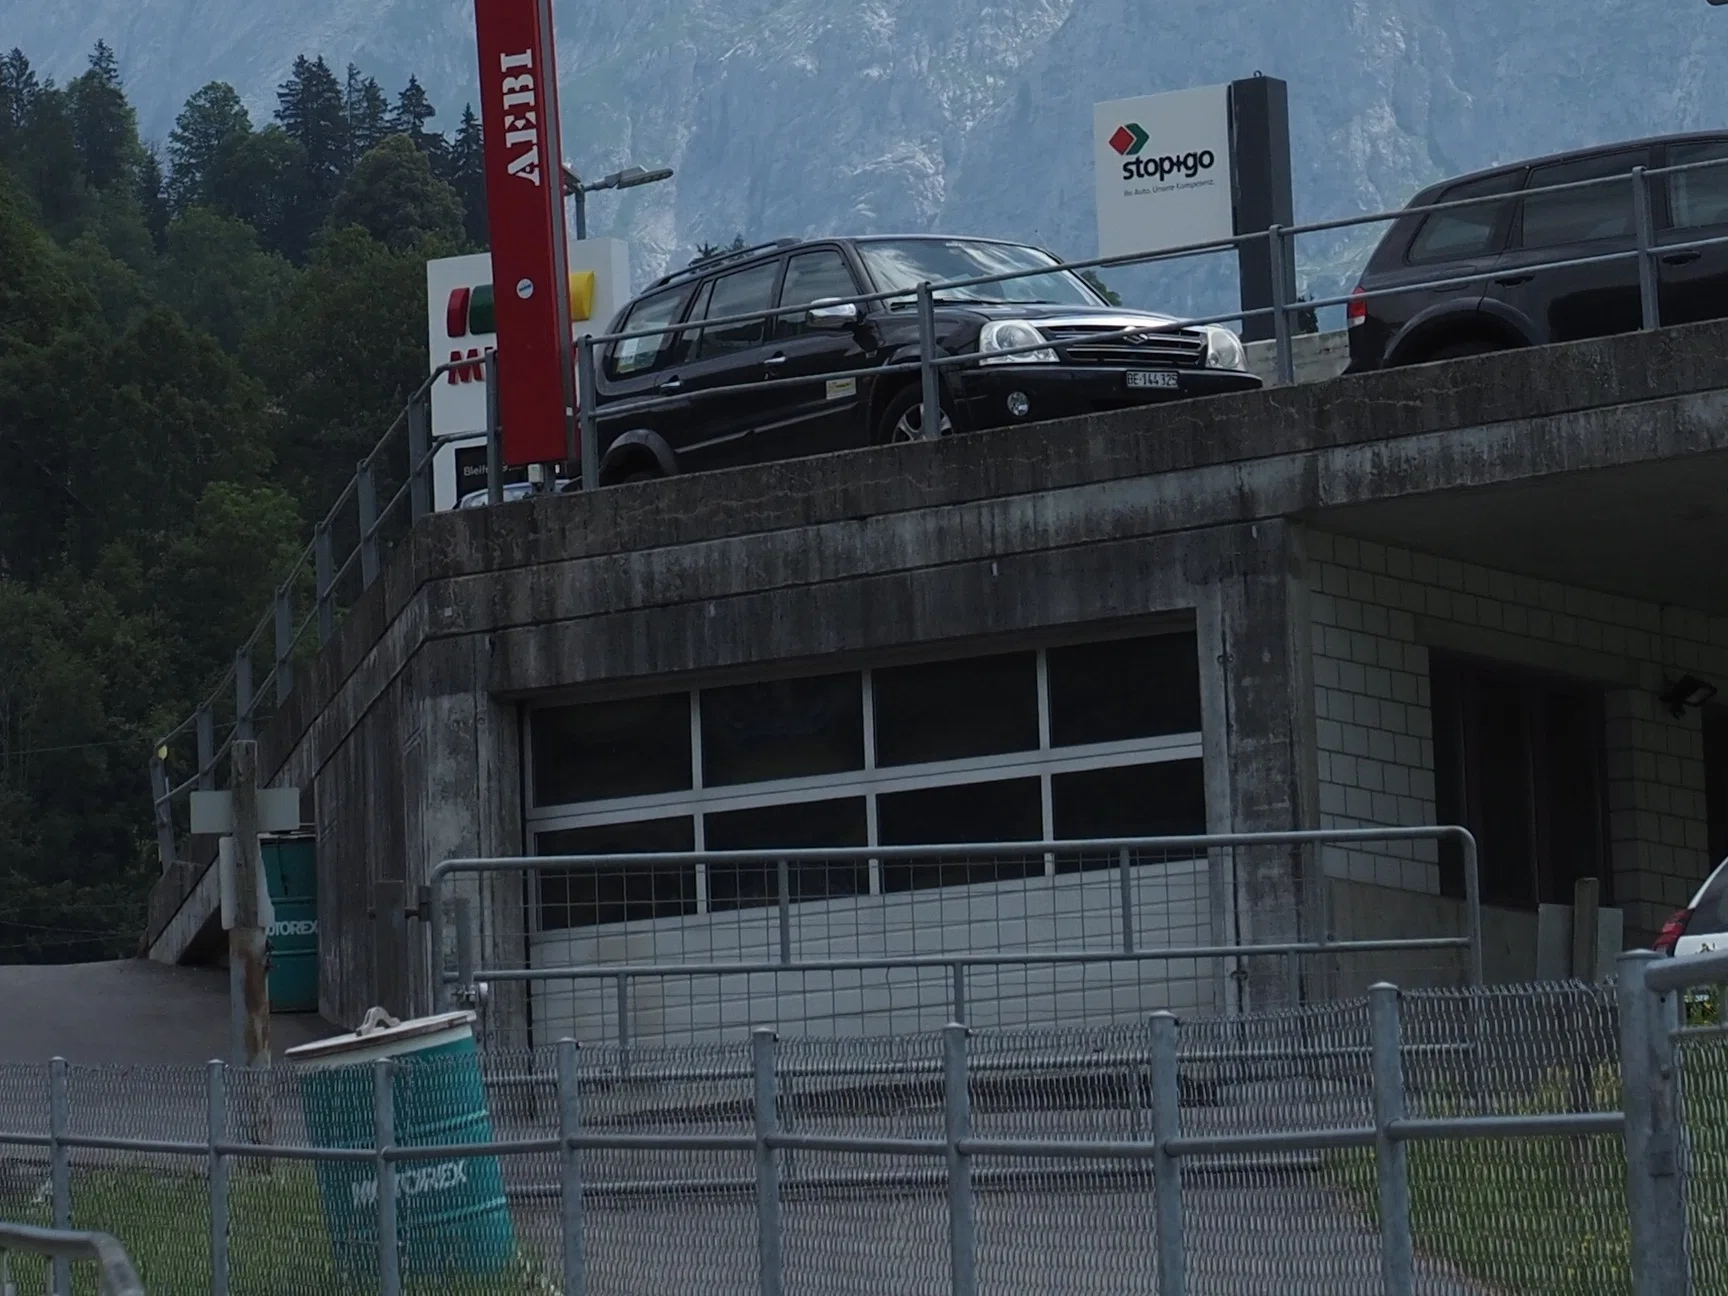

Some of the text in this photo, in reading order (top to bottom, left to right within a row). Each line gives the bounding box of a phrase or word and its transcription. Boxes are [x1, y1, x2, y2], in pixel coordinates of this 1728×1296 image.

[500, 48, 540, 186] AEBI
[1122, 150, 1215, 182] stop+go
[266, 919, 319, 936] OTOREX
[351, 1159, 468, 1209] MTOREX
